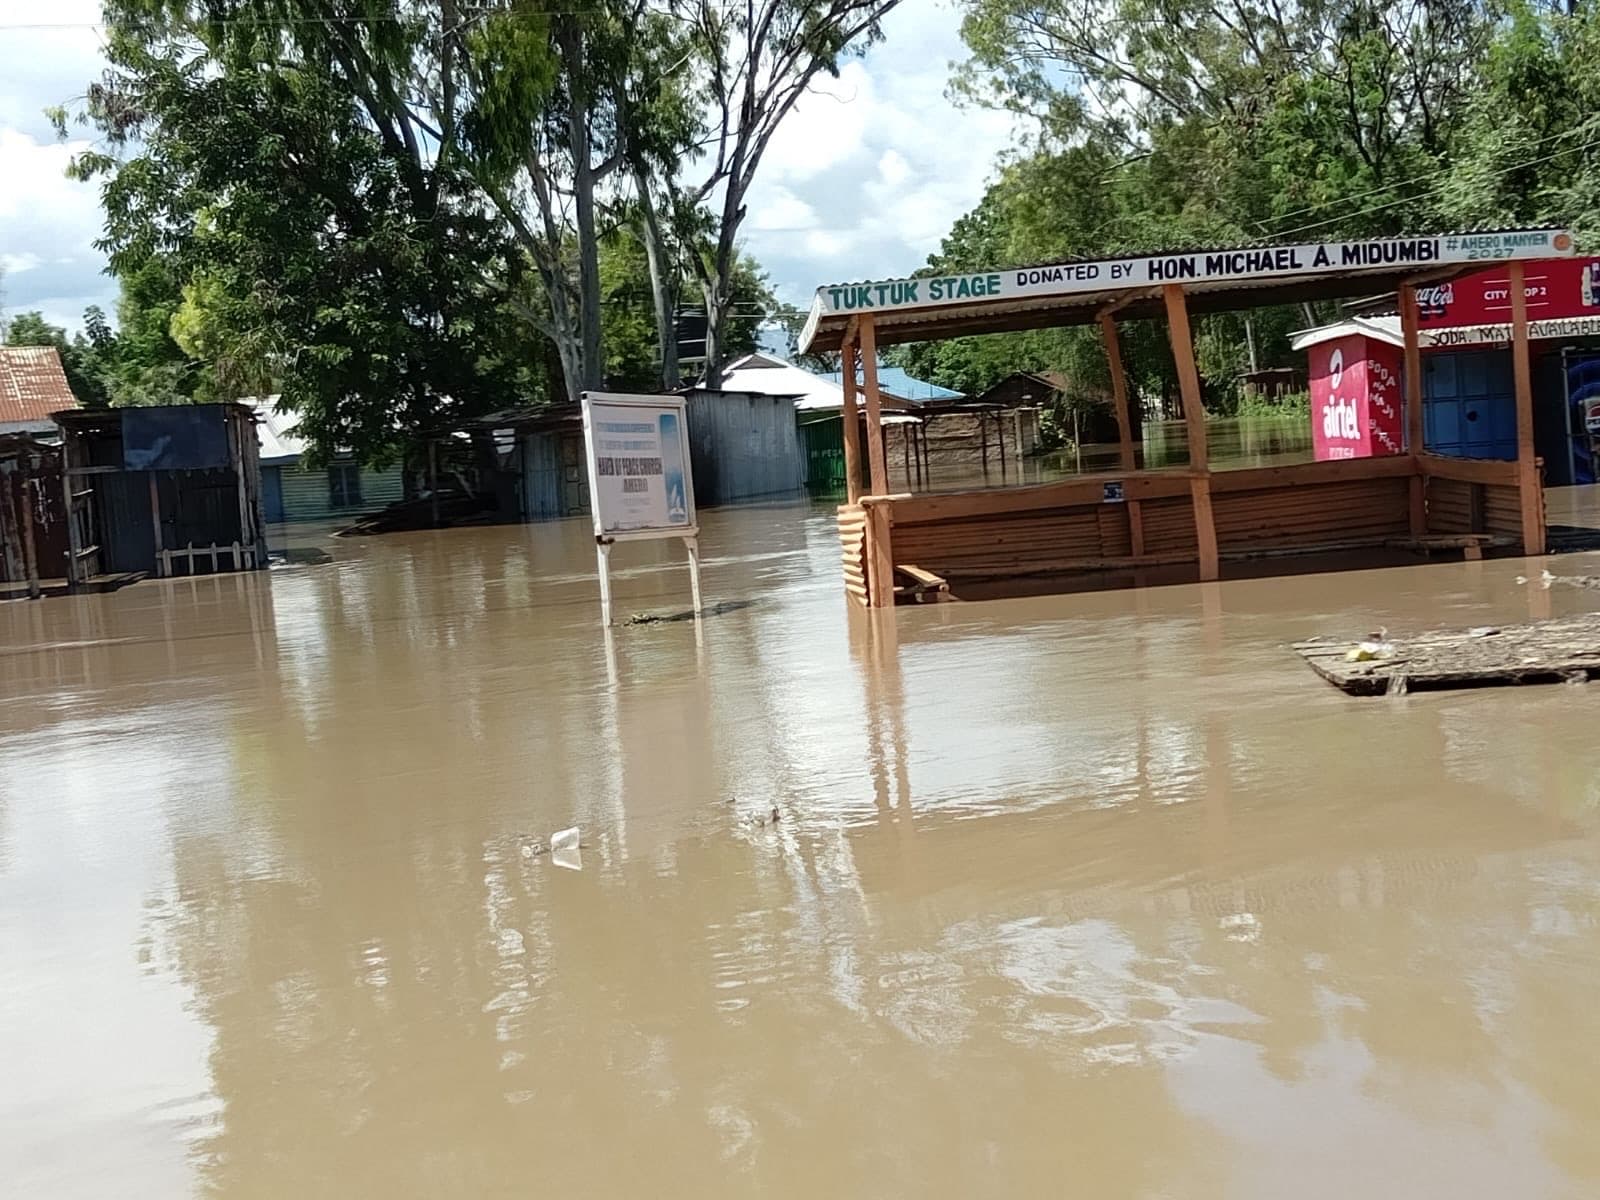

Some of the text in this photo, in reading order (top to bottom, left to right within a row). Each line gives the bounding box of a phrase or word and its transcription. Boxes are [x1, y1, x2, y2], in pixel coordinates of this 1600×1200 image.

[1468, 247, 1515, 260] 2027
[828, 280, 919, 310] TUKTUK
[928, 275, 1001, 301] STAGE
[1016, 264, 1099, 287] DONATED
[1110, 263, 1133, 280] BY
[1148, 257, 1201, 281] HON.
[1206, 248, 1303, 276] MICHAEL
[1312, 245, 1336, 268] A.
[1342, 239, 1440, 265] MIDUMBI
[1484, 290, 1508, 300] CITY
[1540, 286, 1547, 295] 2
[1367, 360, 1396, 387] SODA
[1322, 394, 1360, 440] airtel
